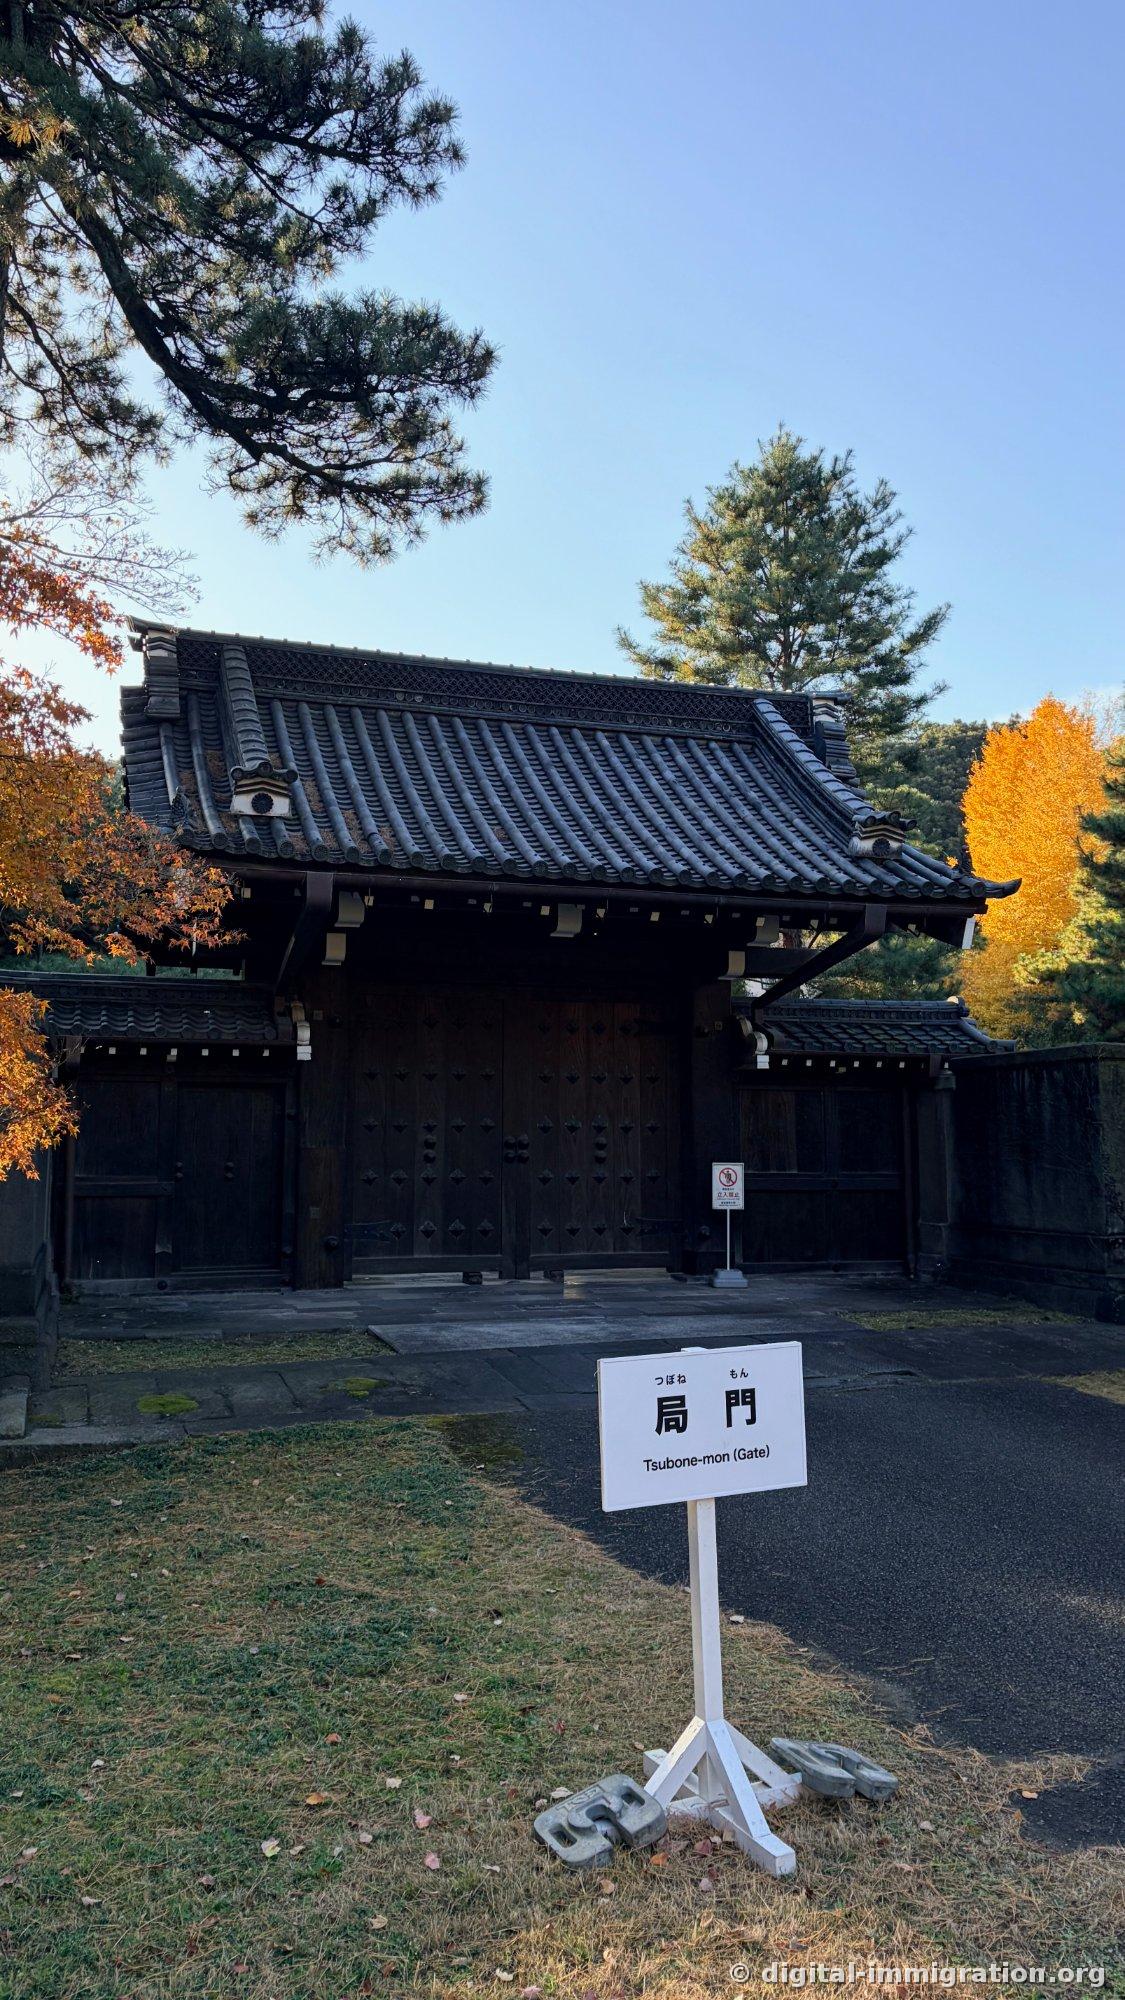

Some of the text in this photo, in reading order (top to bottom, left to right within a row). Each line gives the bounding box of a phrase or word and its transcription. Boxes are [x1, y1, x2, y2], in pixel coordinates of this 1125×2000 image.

[654, 1367, 749, 1386] つぼね もん
[654, 1387, 757, 1436] 局 門
[643, 1444, 770, 1472] Tsubone-mon (Gate)
